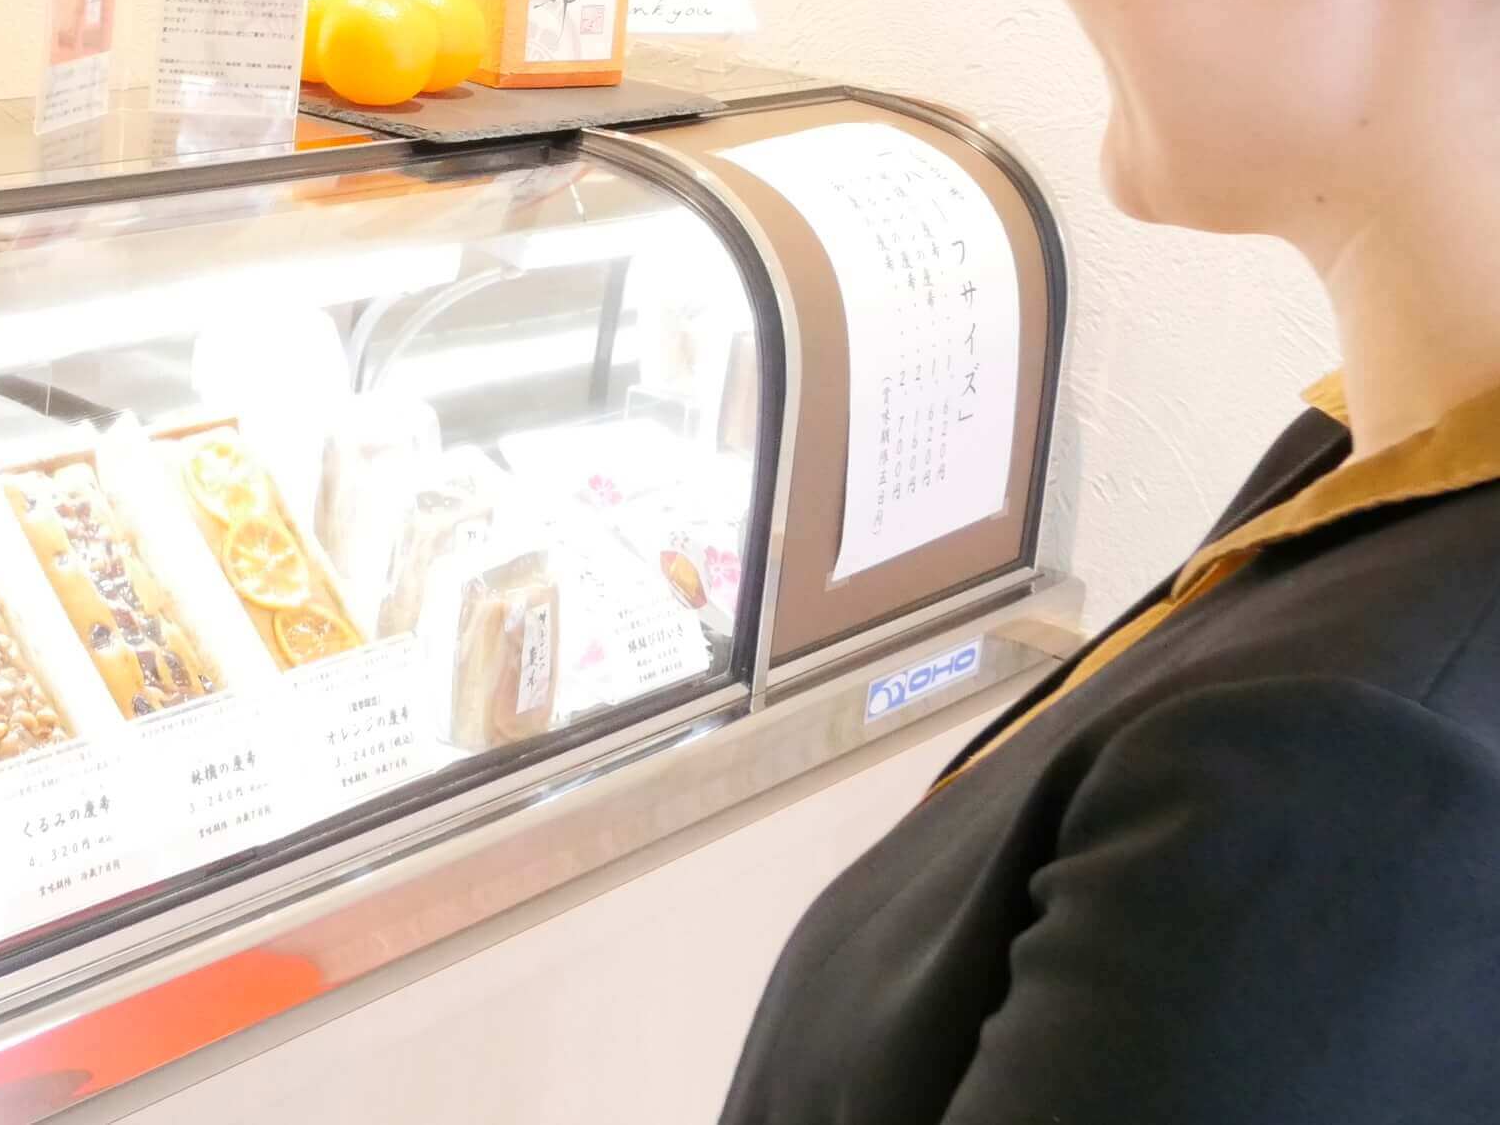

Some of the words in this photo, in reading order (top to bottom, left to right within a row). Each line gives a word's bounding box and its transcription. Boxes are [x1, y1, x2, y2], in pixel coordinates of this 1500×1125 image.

[666, 6, 714, 25] you
[326, 705, 411, 745] オレンジの慶希
[23, 794, 111, 838] くるみの慶希
